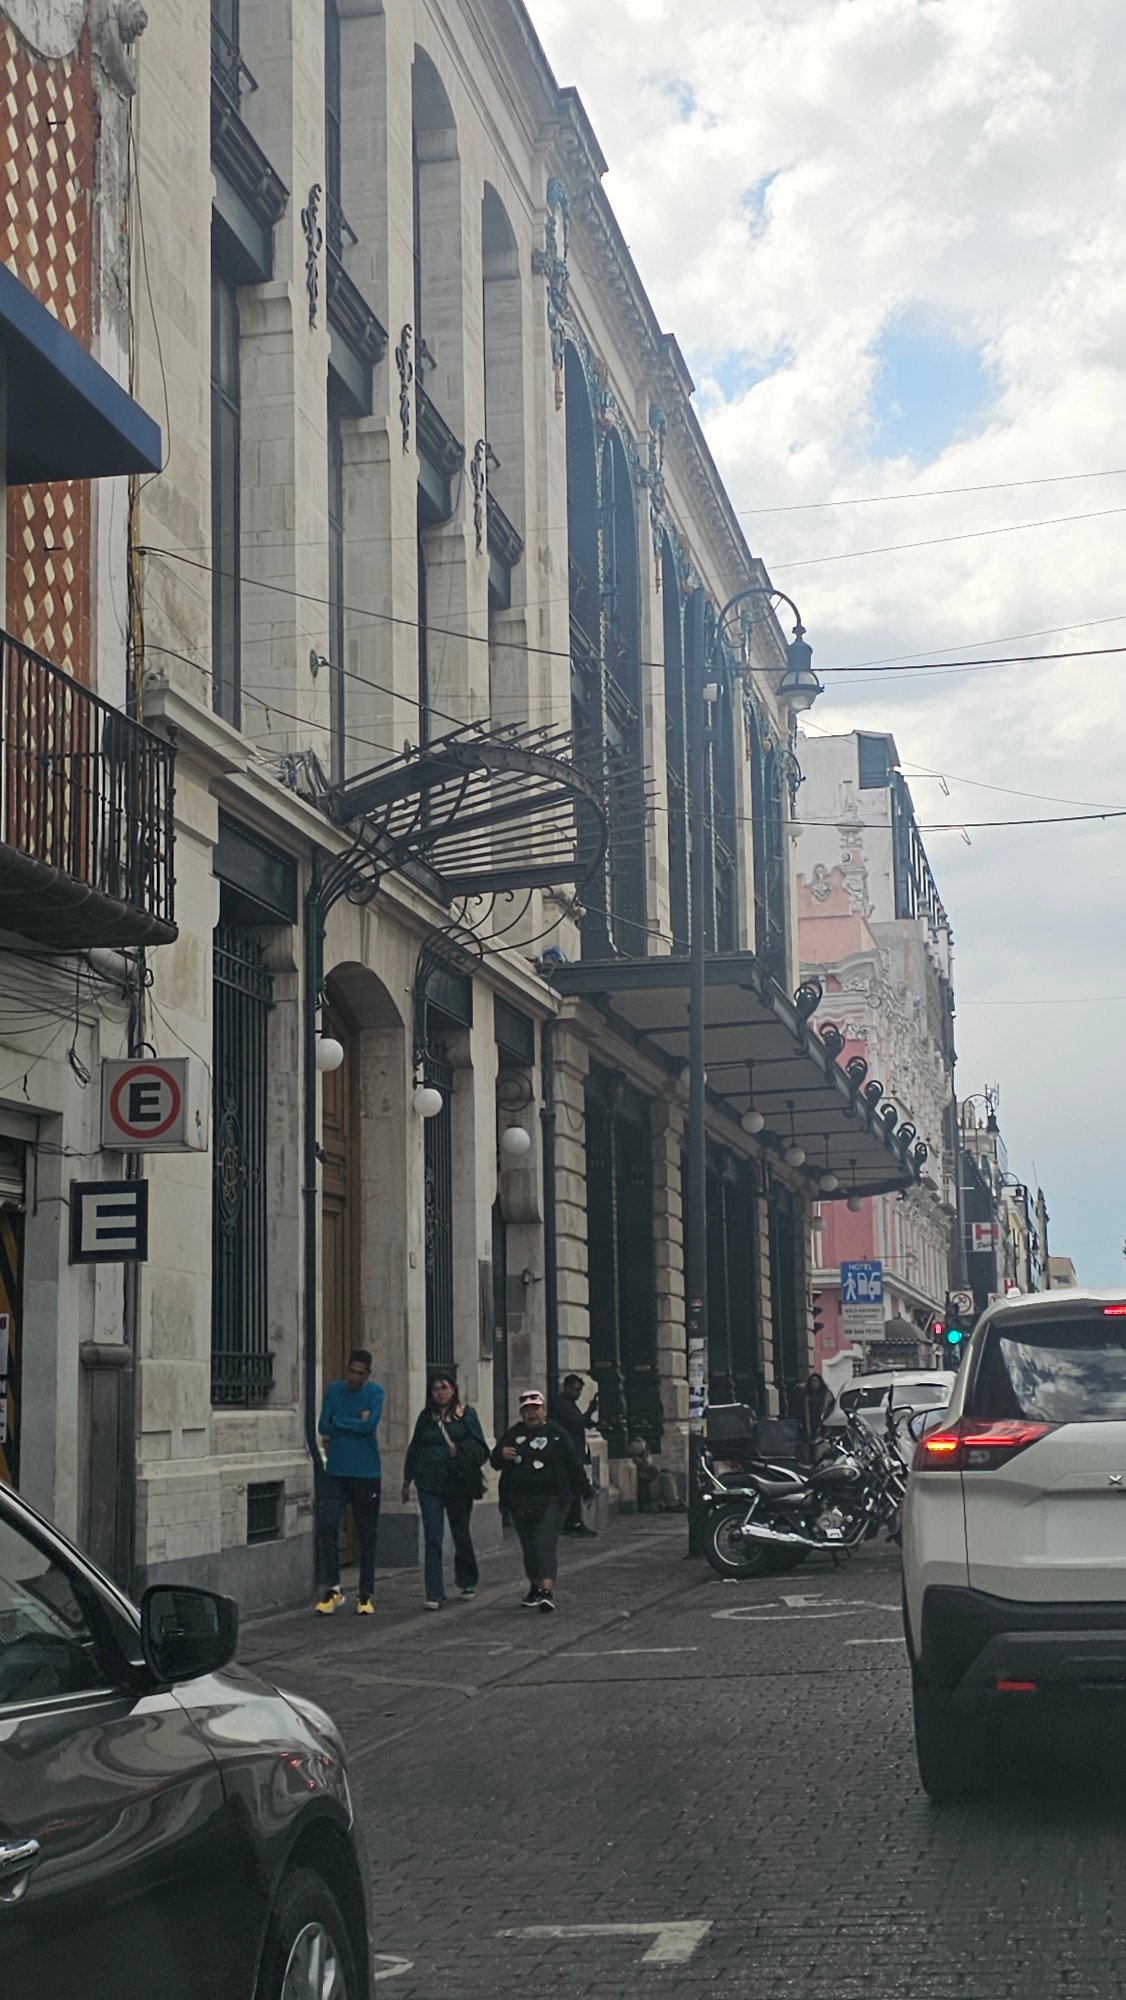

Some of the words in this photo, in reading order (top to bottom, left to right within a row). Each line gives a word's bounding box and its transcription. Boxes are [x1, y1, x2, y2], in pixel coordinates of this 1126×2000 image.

[129, 1082, 161, 1122] E
[81, 1193, 136, 1251] E
[975, 1223, 999, 1240] H
[848, 1263, 873, 1271] HOTEL
